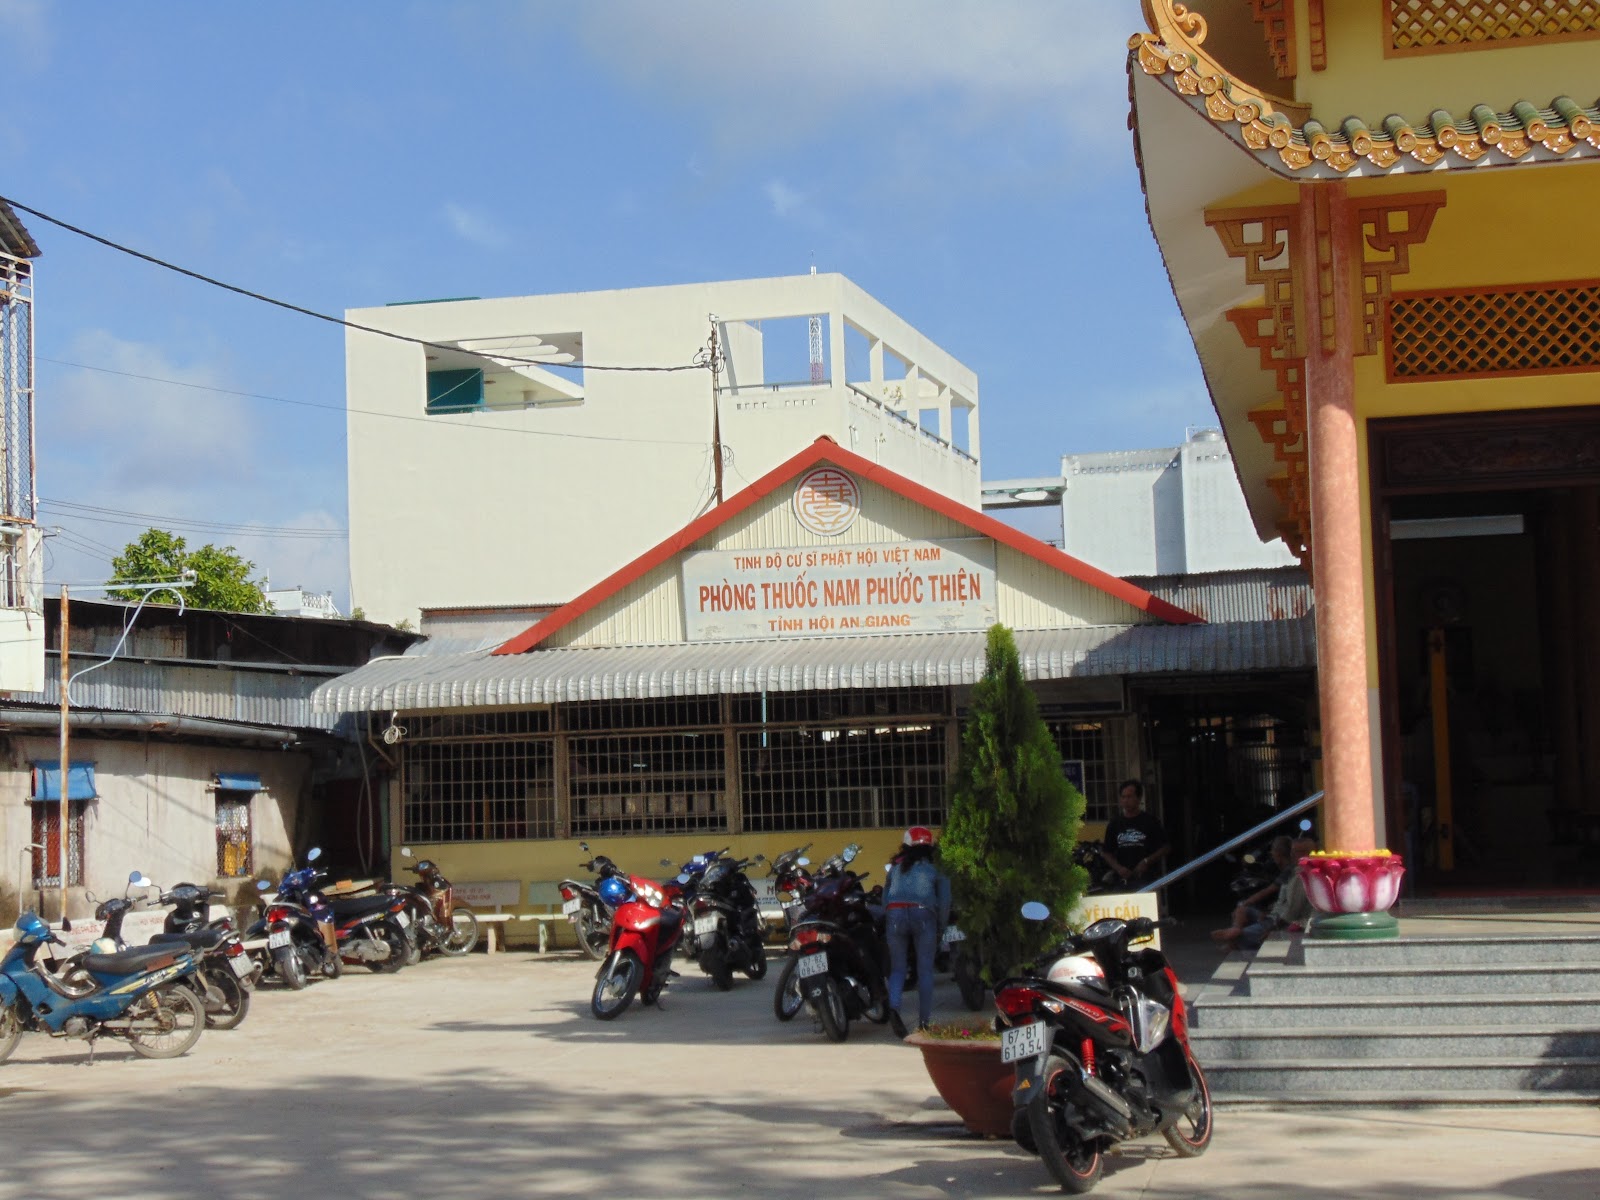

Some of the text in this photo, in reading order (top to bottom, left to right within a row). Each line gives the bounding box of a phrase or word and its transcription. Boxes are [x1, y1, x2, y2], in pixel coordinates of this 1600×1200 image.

[734, 546, 941, 572] TỊNH ĐỘ CƯ SĨ PHẬT HỘI VIỆT NAM
[699, 567, 981, 613] PHÒNG THUỐC NAM PHƯỚC THIỆN
[768, 614, 911, 632] TỈNH HỘI AN GIANG
[1084, 904, 1110, 920] YÊU
[1008, 1024, 1038, 1044] 67-B1
